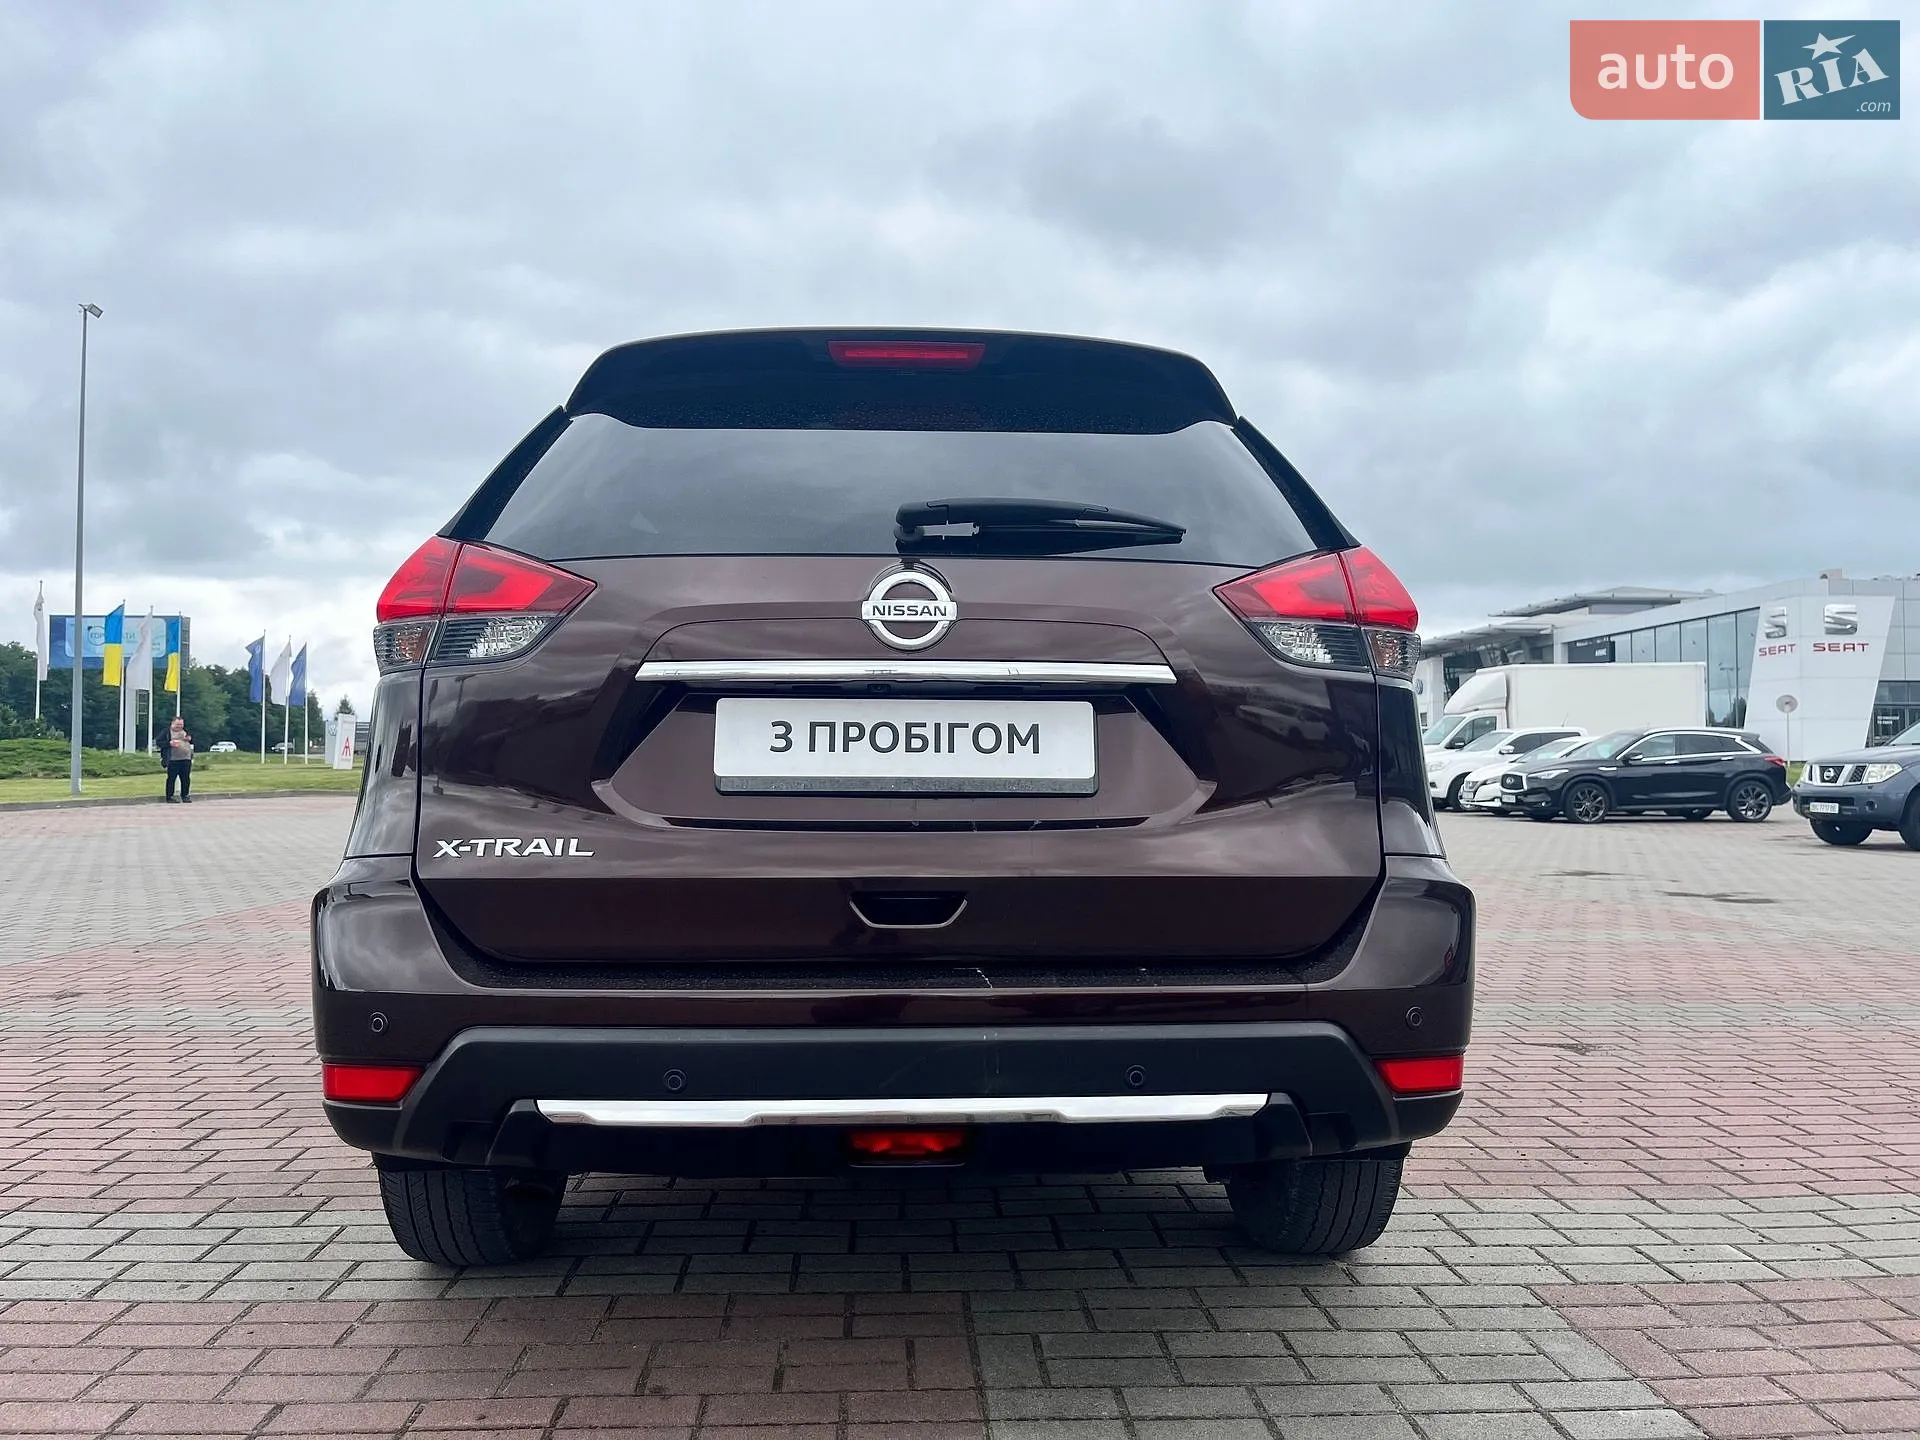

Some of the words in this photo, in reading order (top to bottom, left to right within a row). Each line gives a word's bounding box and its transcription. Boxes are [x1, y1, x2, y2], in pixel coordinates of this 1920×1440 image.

[872, 604, 947, 617] NISSAN
[1758, 643, 1796, 657] SEAT
[1812, 642, 1869, 652] SEAT
[808, 721, 1041, 754] ПРОБІГОМ
[432, 838, 595, 858] X-TRAIL
